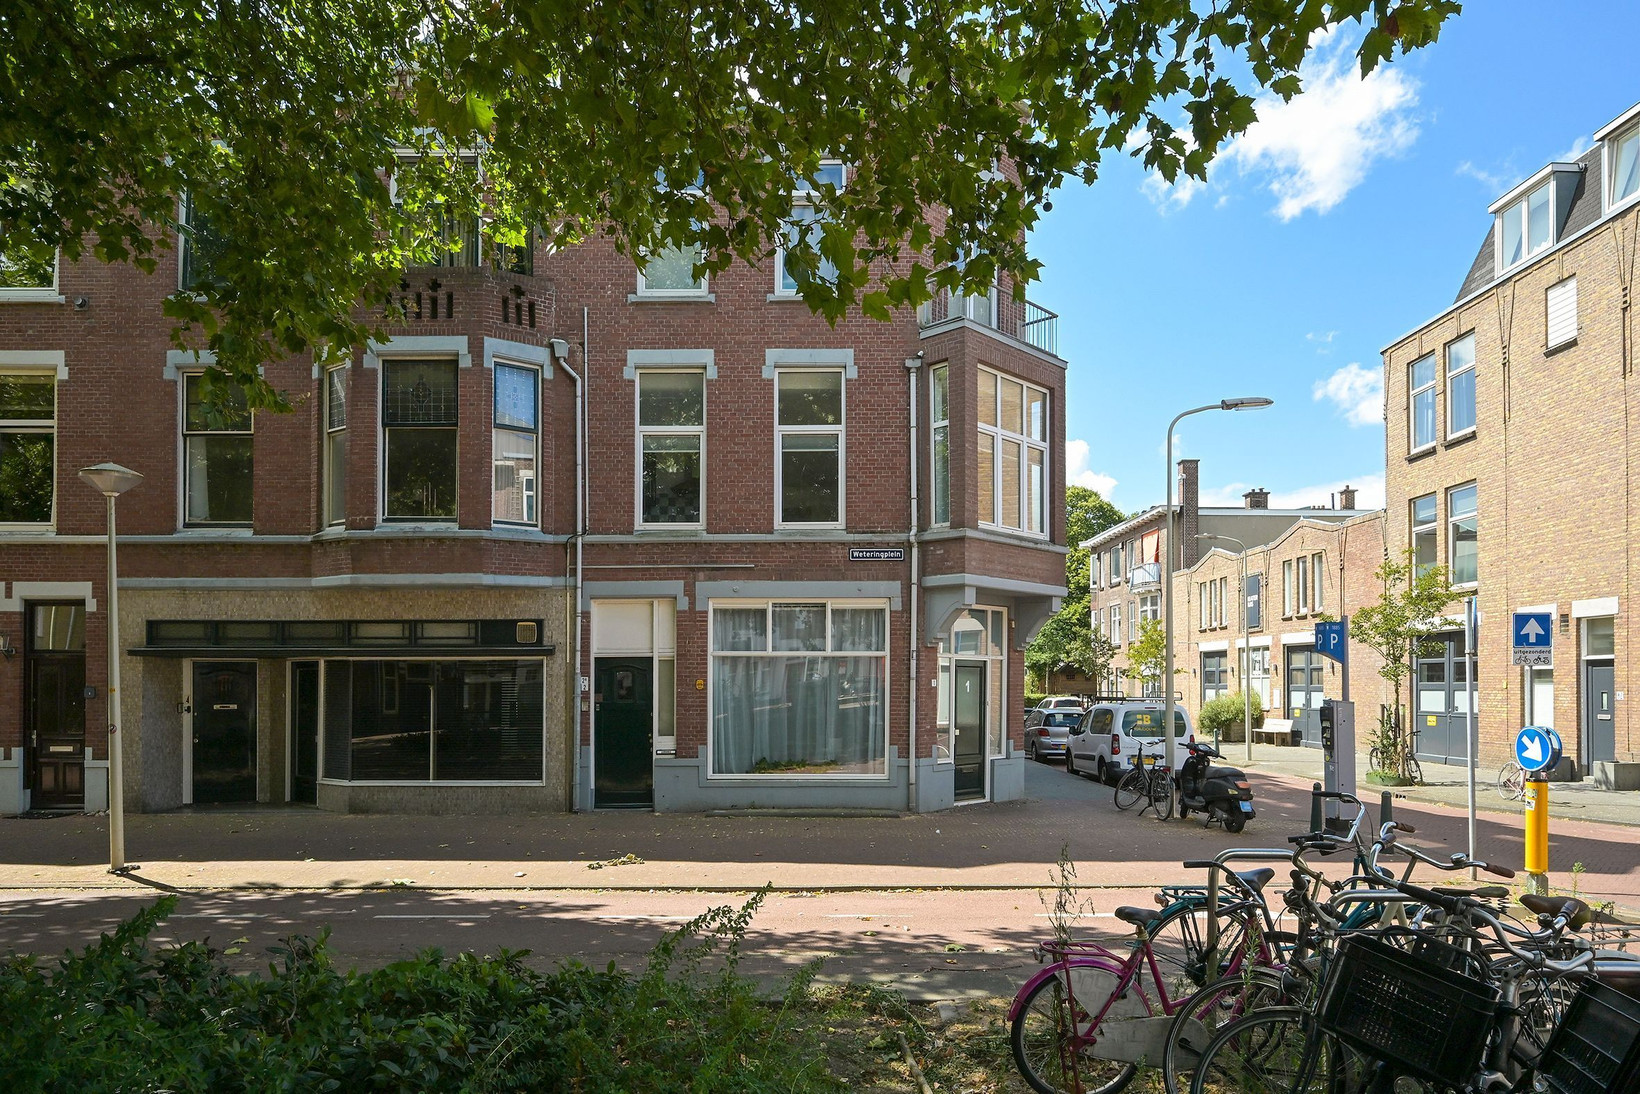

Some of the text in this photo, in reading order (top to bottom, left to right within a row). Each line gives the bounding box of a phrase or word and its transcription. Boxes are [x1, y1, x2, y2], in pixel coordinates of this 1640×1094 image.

[853, 551, 901, 559] Weteringplein
[1331, 634, 1338, 649] P
[965, 680, 970, 693] 1
